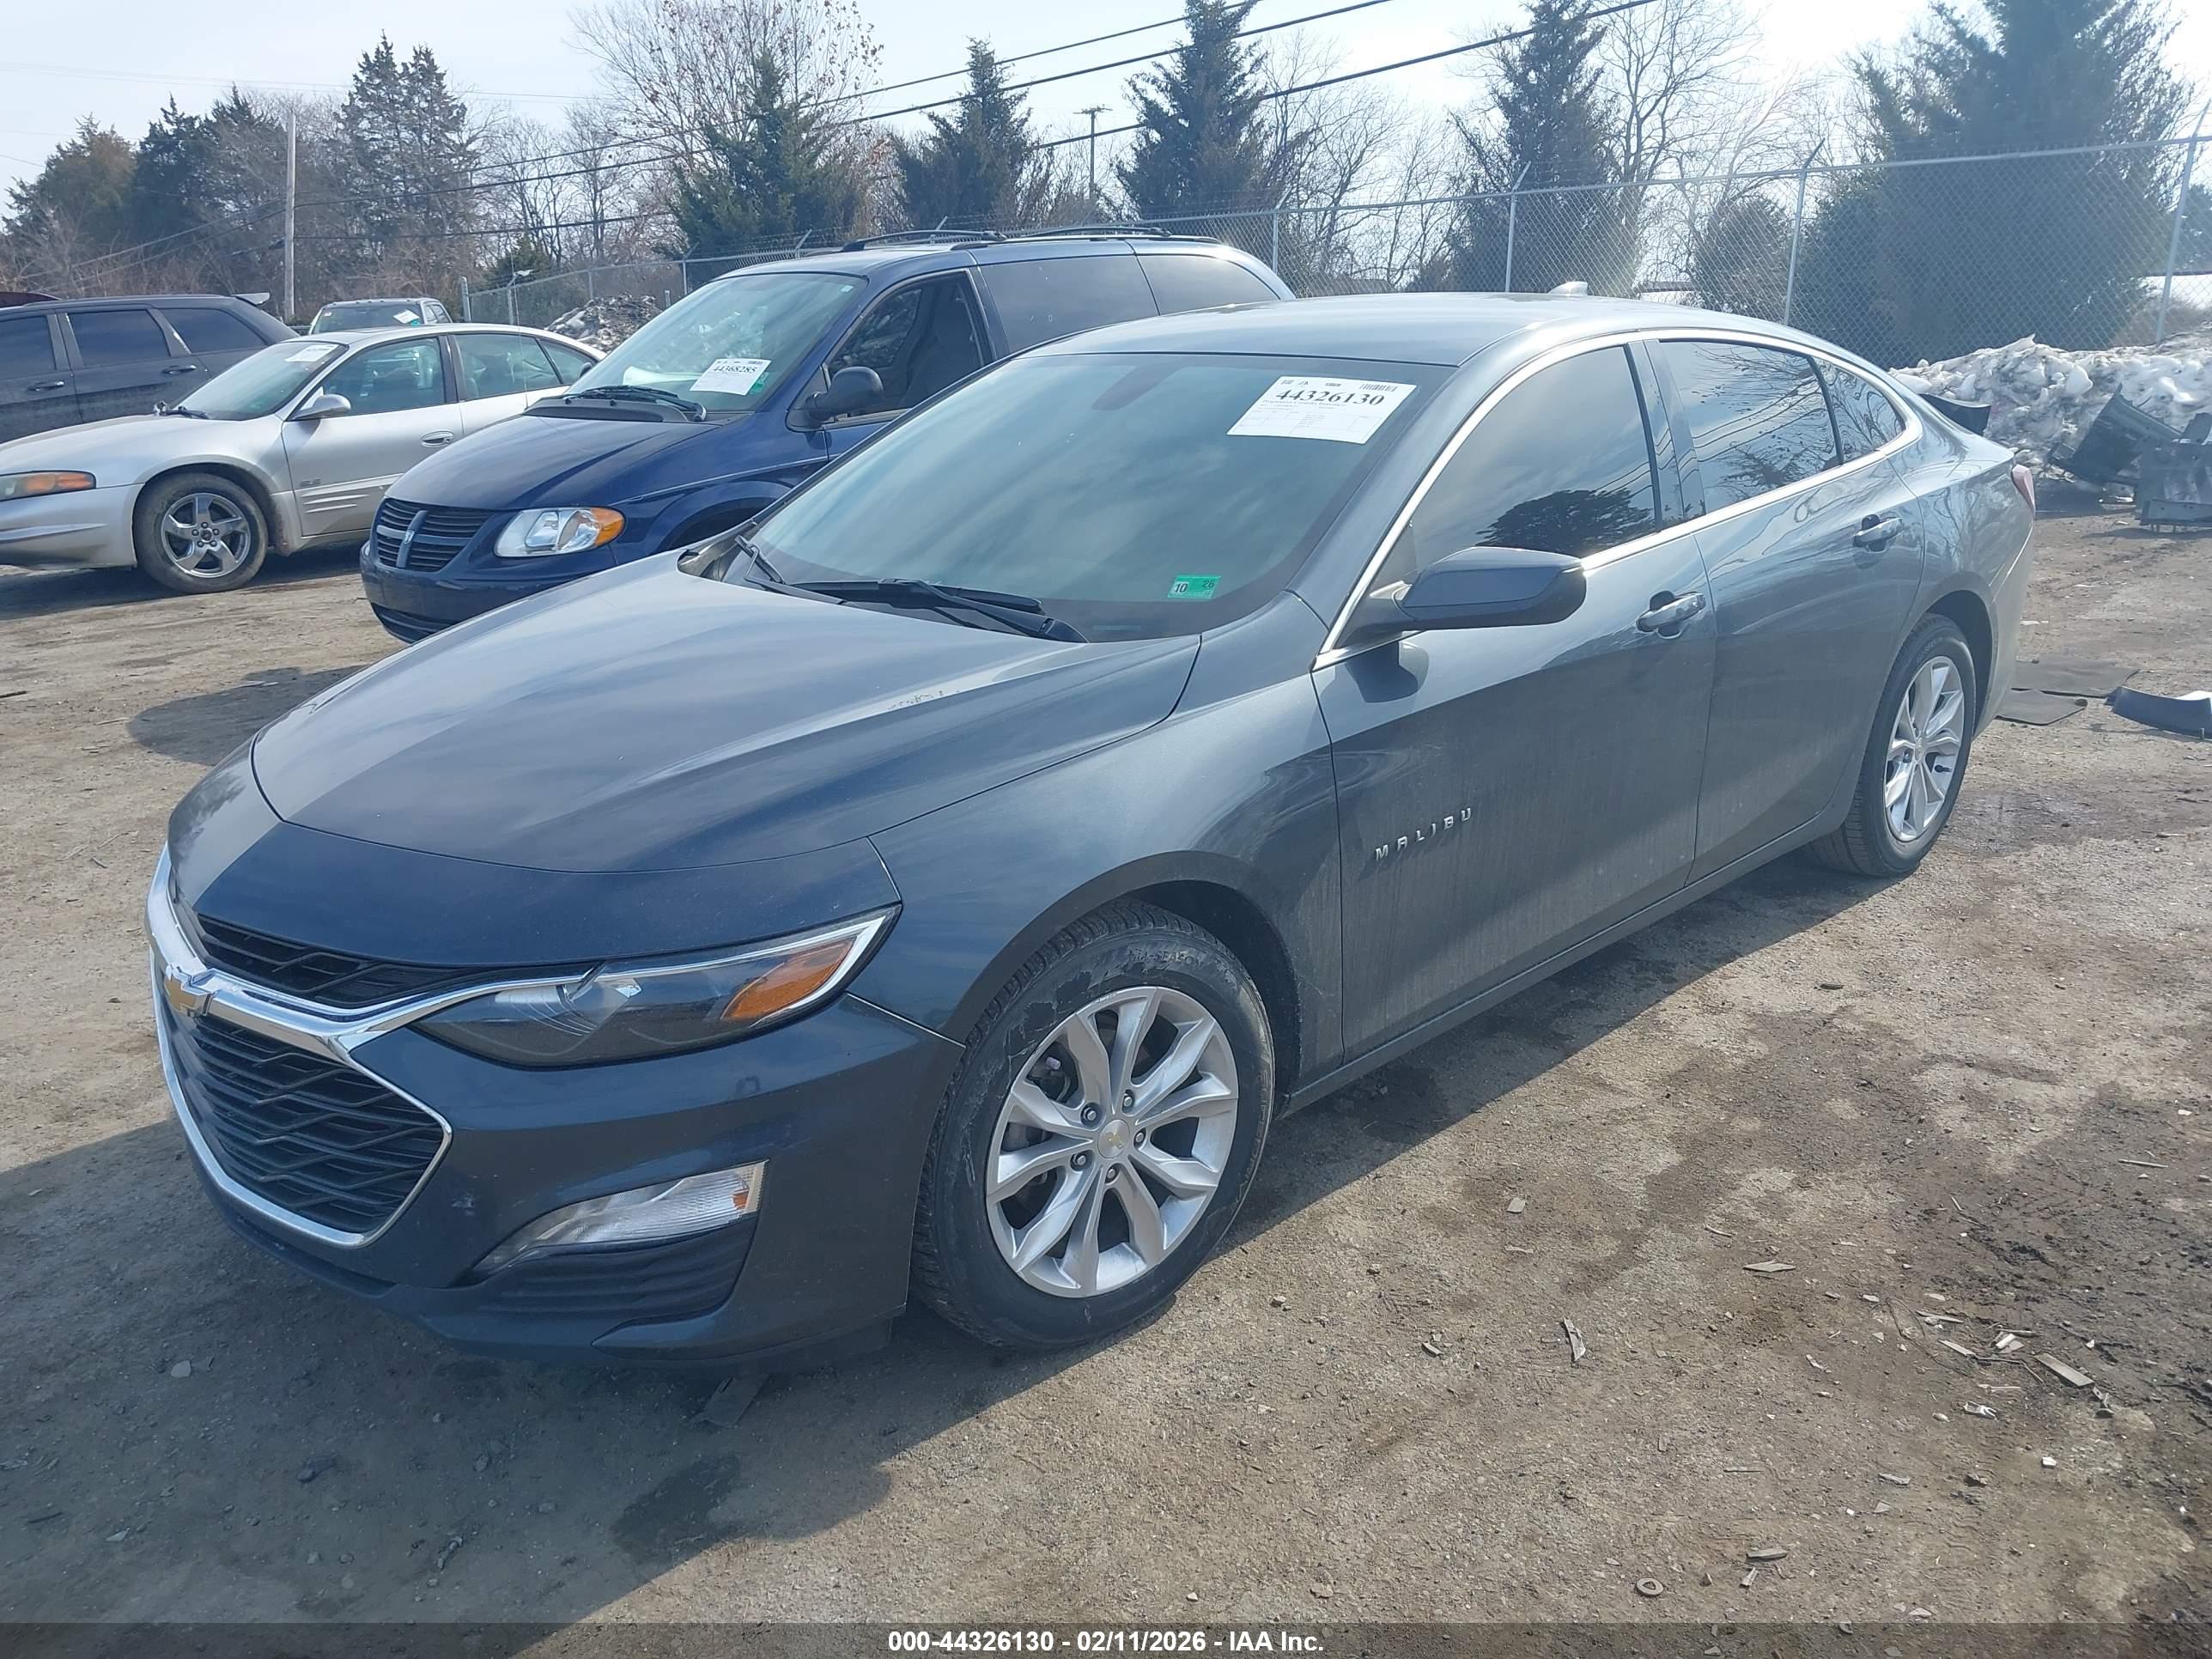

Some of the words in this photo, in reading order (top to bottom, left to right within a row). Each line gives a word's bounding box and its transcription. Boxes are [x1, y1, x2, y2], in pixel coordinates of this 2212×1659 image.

[1275, 389, 1385, 406] 44326130
[1175, 582, 1188, 593] 10
[1375, 807, 1472, 861] MALIBU
